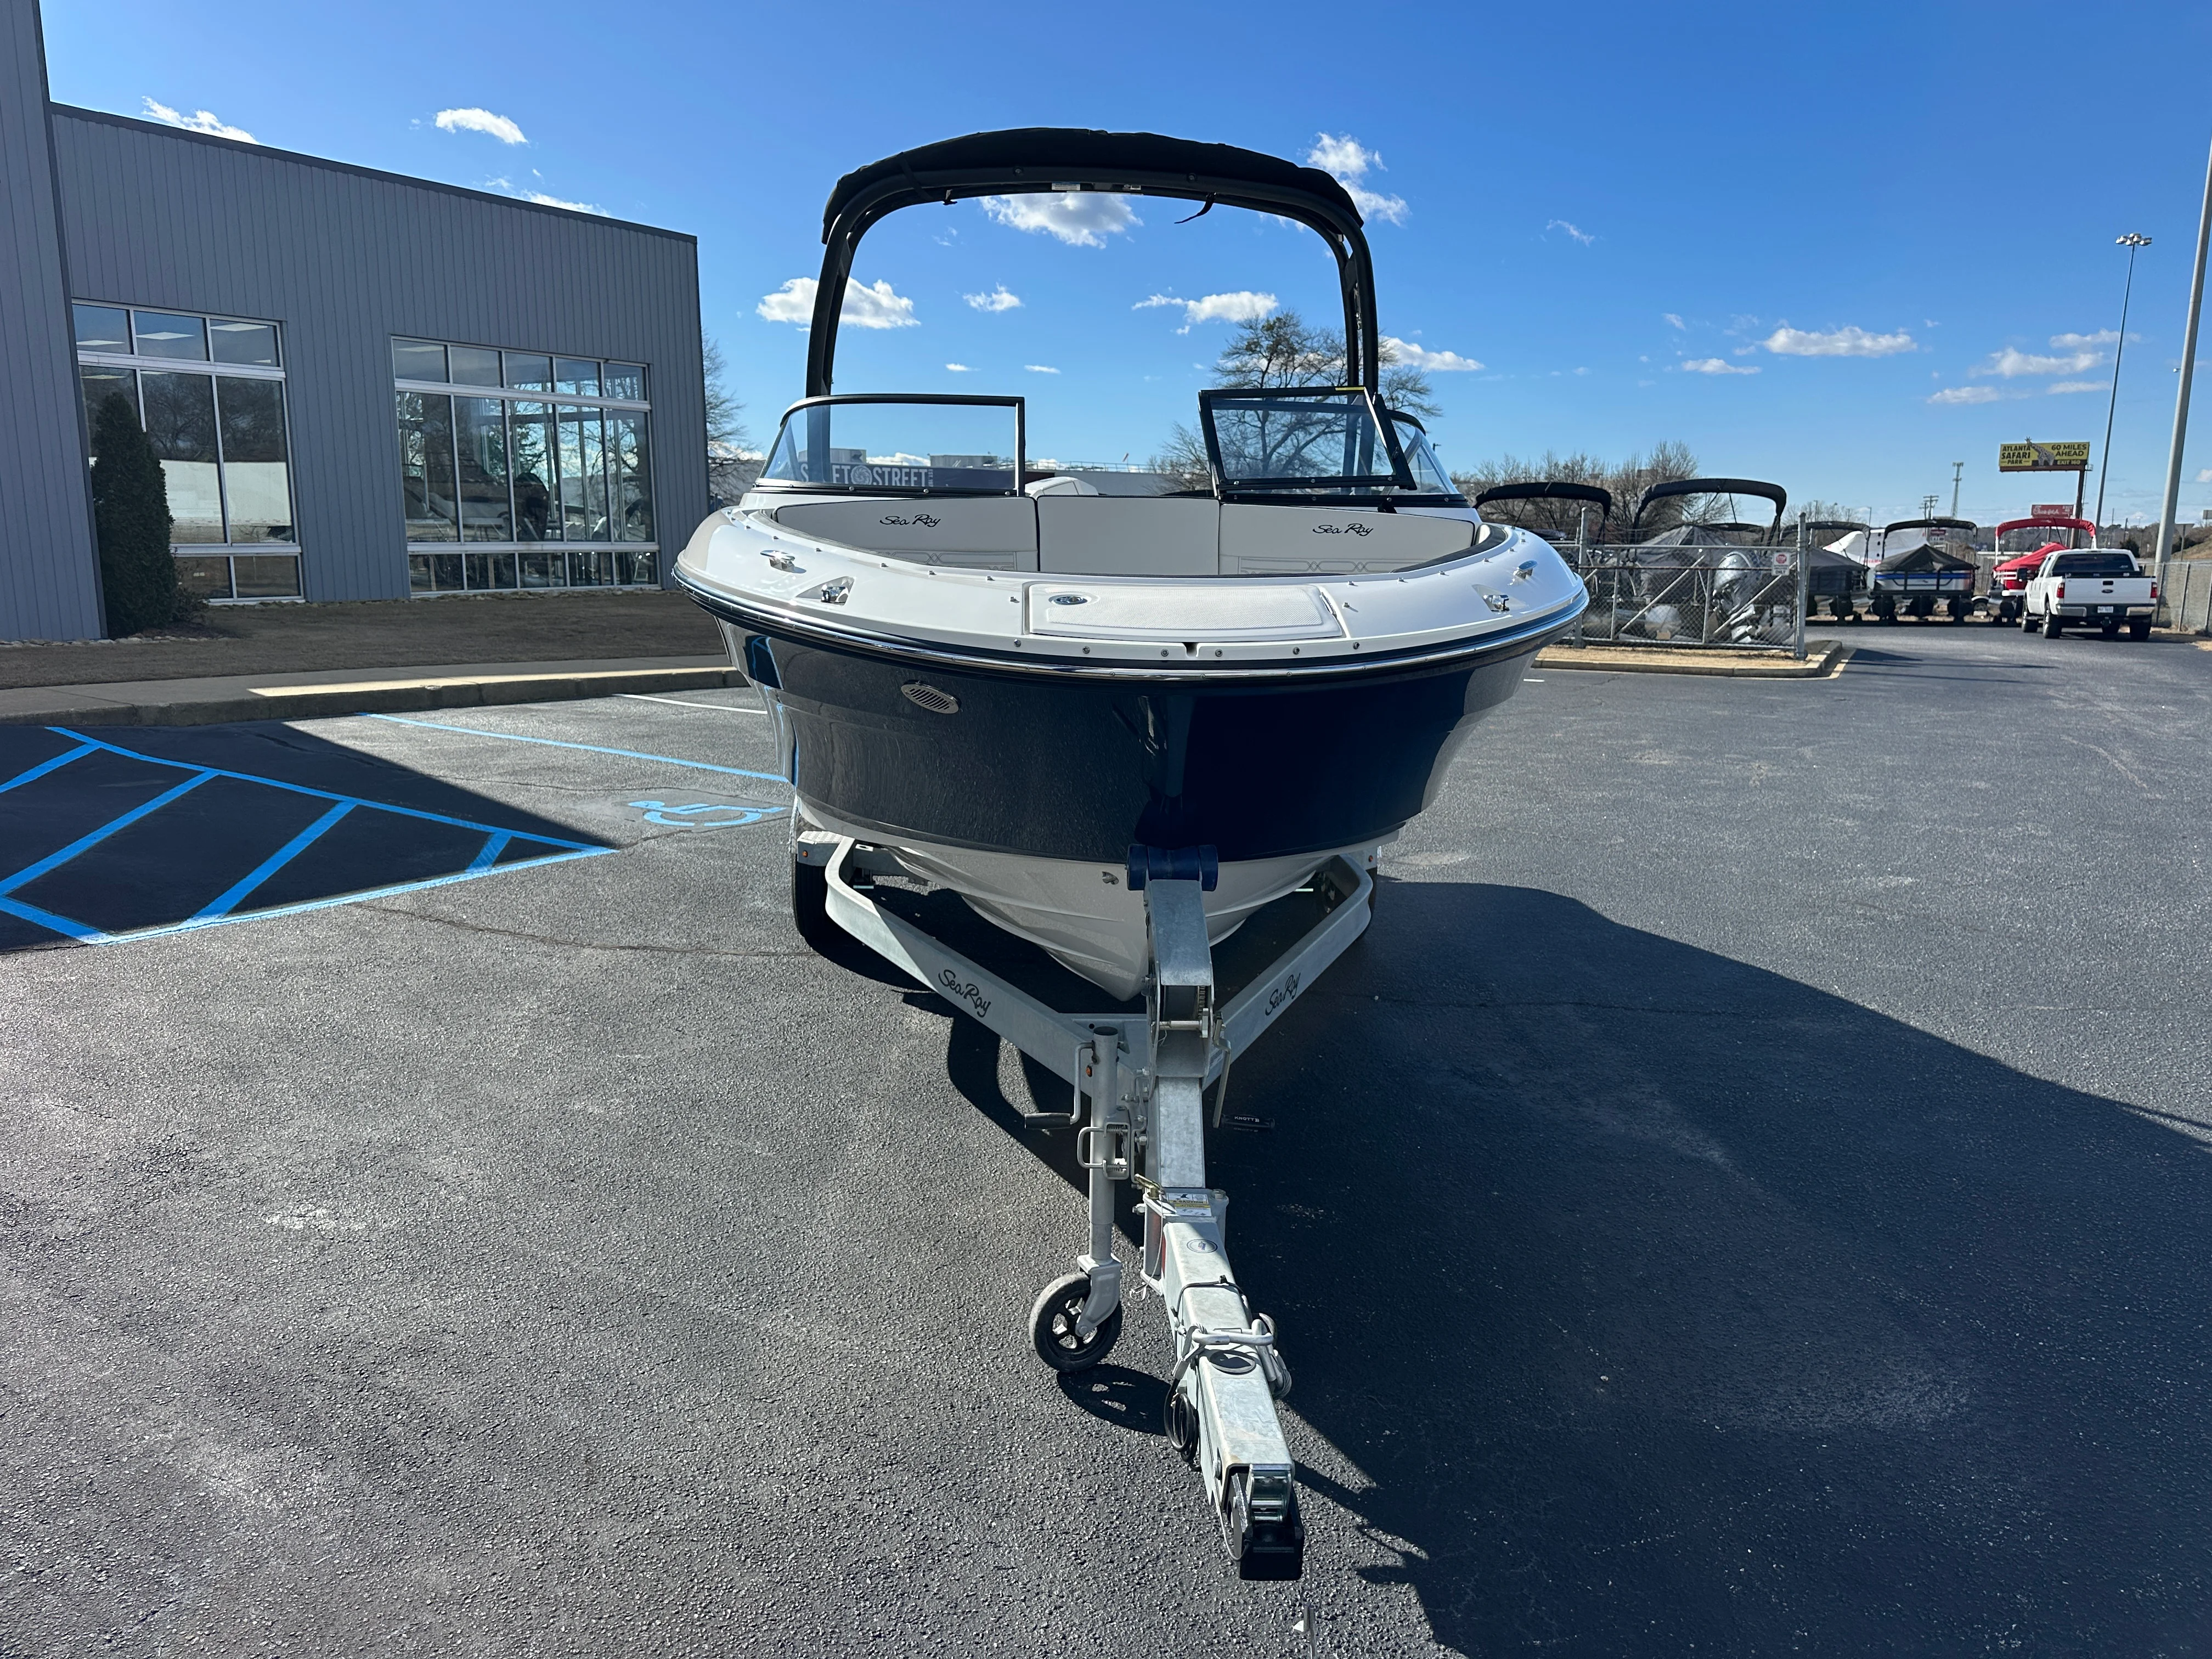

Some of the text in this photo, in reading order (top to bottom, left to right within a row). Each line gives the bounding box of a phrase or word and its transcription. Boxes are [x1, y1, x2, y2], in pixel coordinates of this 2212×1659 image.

[873, 467, 928, 487] STREET
[879, 514, 941, 528] Sea Ray
[1312, 523, 1374, 537] Sea Ray
[938, 969, 991, 1018] Sea Ray
[1265, 972, 1301, 1016] Sea Ray
